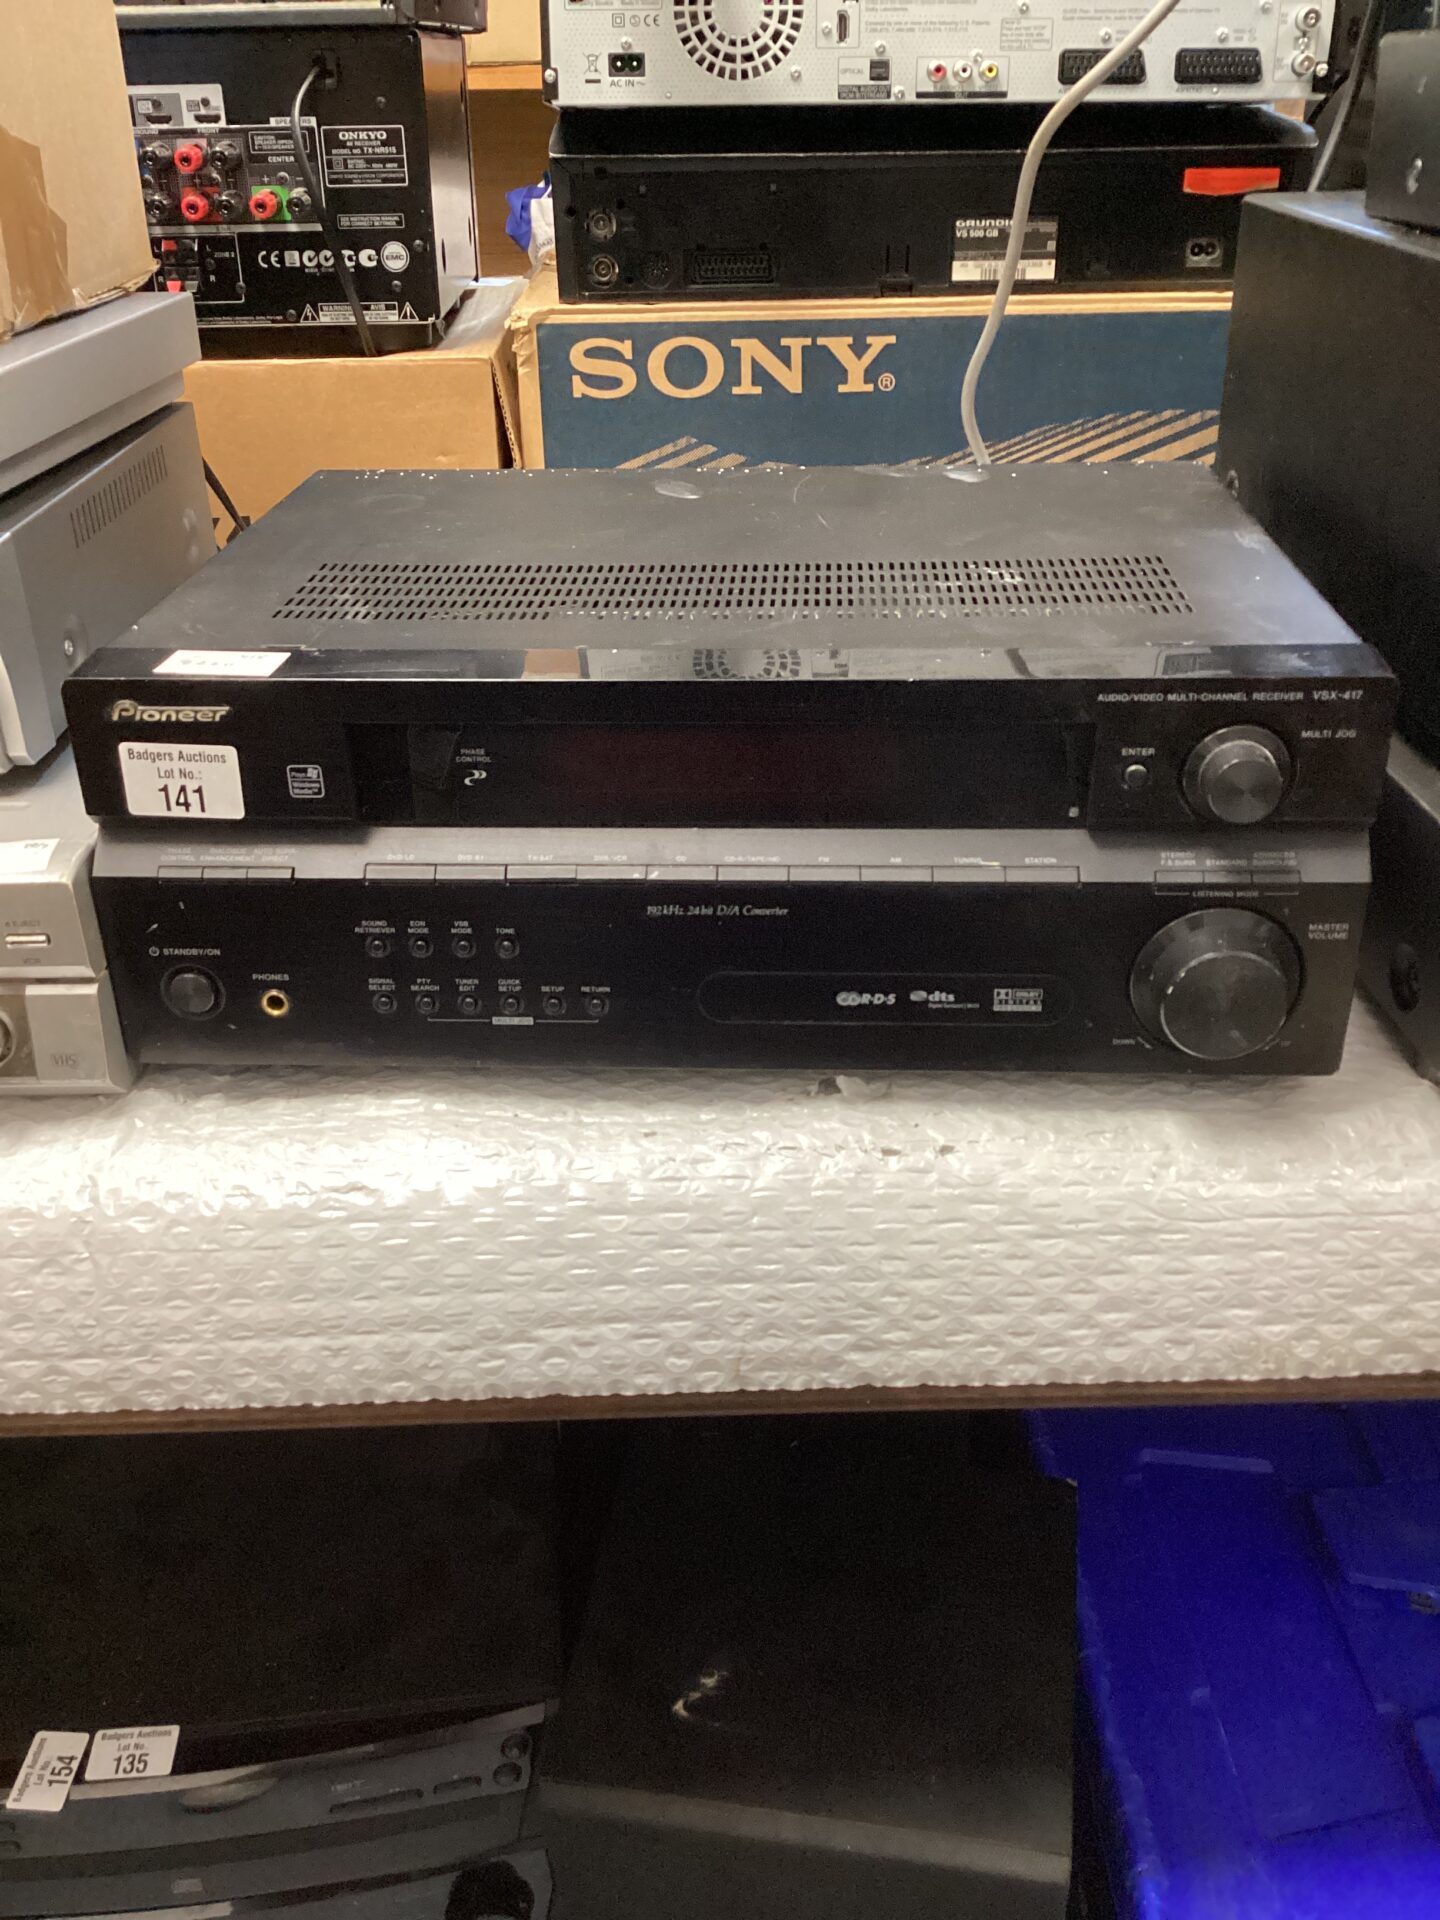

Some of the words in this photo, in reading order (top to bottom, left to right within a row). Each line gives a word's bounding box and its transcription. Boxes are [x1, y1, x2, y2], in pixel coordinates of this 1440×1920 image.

[609, 80, 622, 88] AC
[625, 80, 635, 88] IN
[338, 130, 388, 141] ONKYO
[362, 145, 397, 154] TX-NR515
[267, 155, 295, 163] CENTER
[956, 229, 968, 238] VS
[986, 229, 999, 238] GB
[569, 335, 897, 400] SONY
[1096, 692, 1165, 702] AUDIO/VIDEO
[1167, 692, 1249, 702] MULTI-CHANNEL
[1252, 691, 1304, 701] RECEIVER
[1312, 690, 1364, 701] VSX-417
[111, 699, 233, 723] Pioneer
[1301, 729, 1333, 739] MULTI
[1334, 729, 1357, 739] JOG
[127, 748, 174, 764] Badgers
[177, 750, 227, 765] Auctions
[460, 748, 486, 756] PHASE
[1121, 747, 1156, 757] ENTER
[455, 756, 492, 764] CONTROL
[156, 767, 175, 780] Lot
[157, 783, 207, 814] 141
[1024, 856, 1058, 864] STATION
[716, 904, 741, 916] D/A
[742, 904, 790, 917] Converter
[361, 919, 388, 927] SOUND
[1308, 922, 1350, 931] MASTER
[451, 927, 473, 935] MODE
[495, 927, 516, 935] TONE
[1307, 931, 1349, 940] VOLUME
[162, 947, 221, 956] STANDBY/ON
[252, 973, 290, 981] PHONES
[367, 984, 396, 992] SELECT
[410, 984, 440, 992] SEARCH
[458, 984, 476, 992] EDIT
[927, 990, 955, 1002] dts
[52, 1054, 77, 1067] VHS
[101, 1731, 135, 1742] Badgers
[137, 1729, 172, 1739] Auctions
[117, 1743, 131, 1752] Lot
[113, 1753, 150, 1775] 135
[13, 1767, 30, 1803] Badgers
[27, 1737, 48, 1771] Auctions
[47, 1755, 78, 1788] 154
[33, 1770, 45, 1787] Lot
